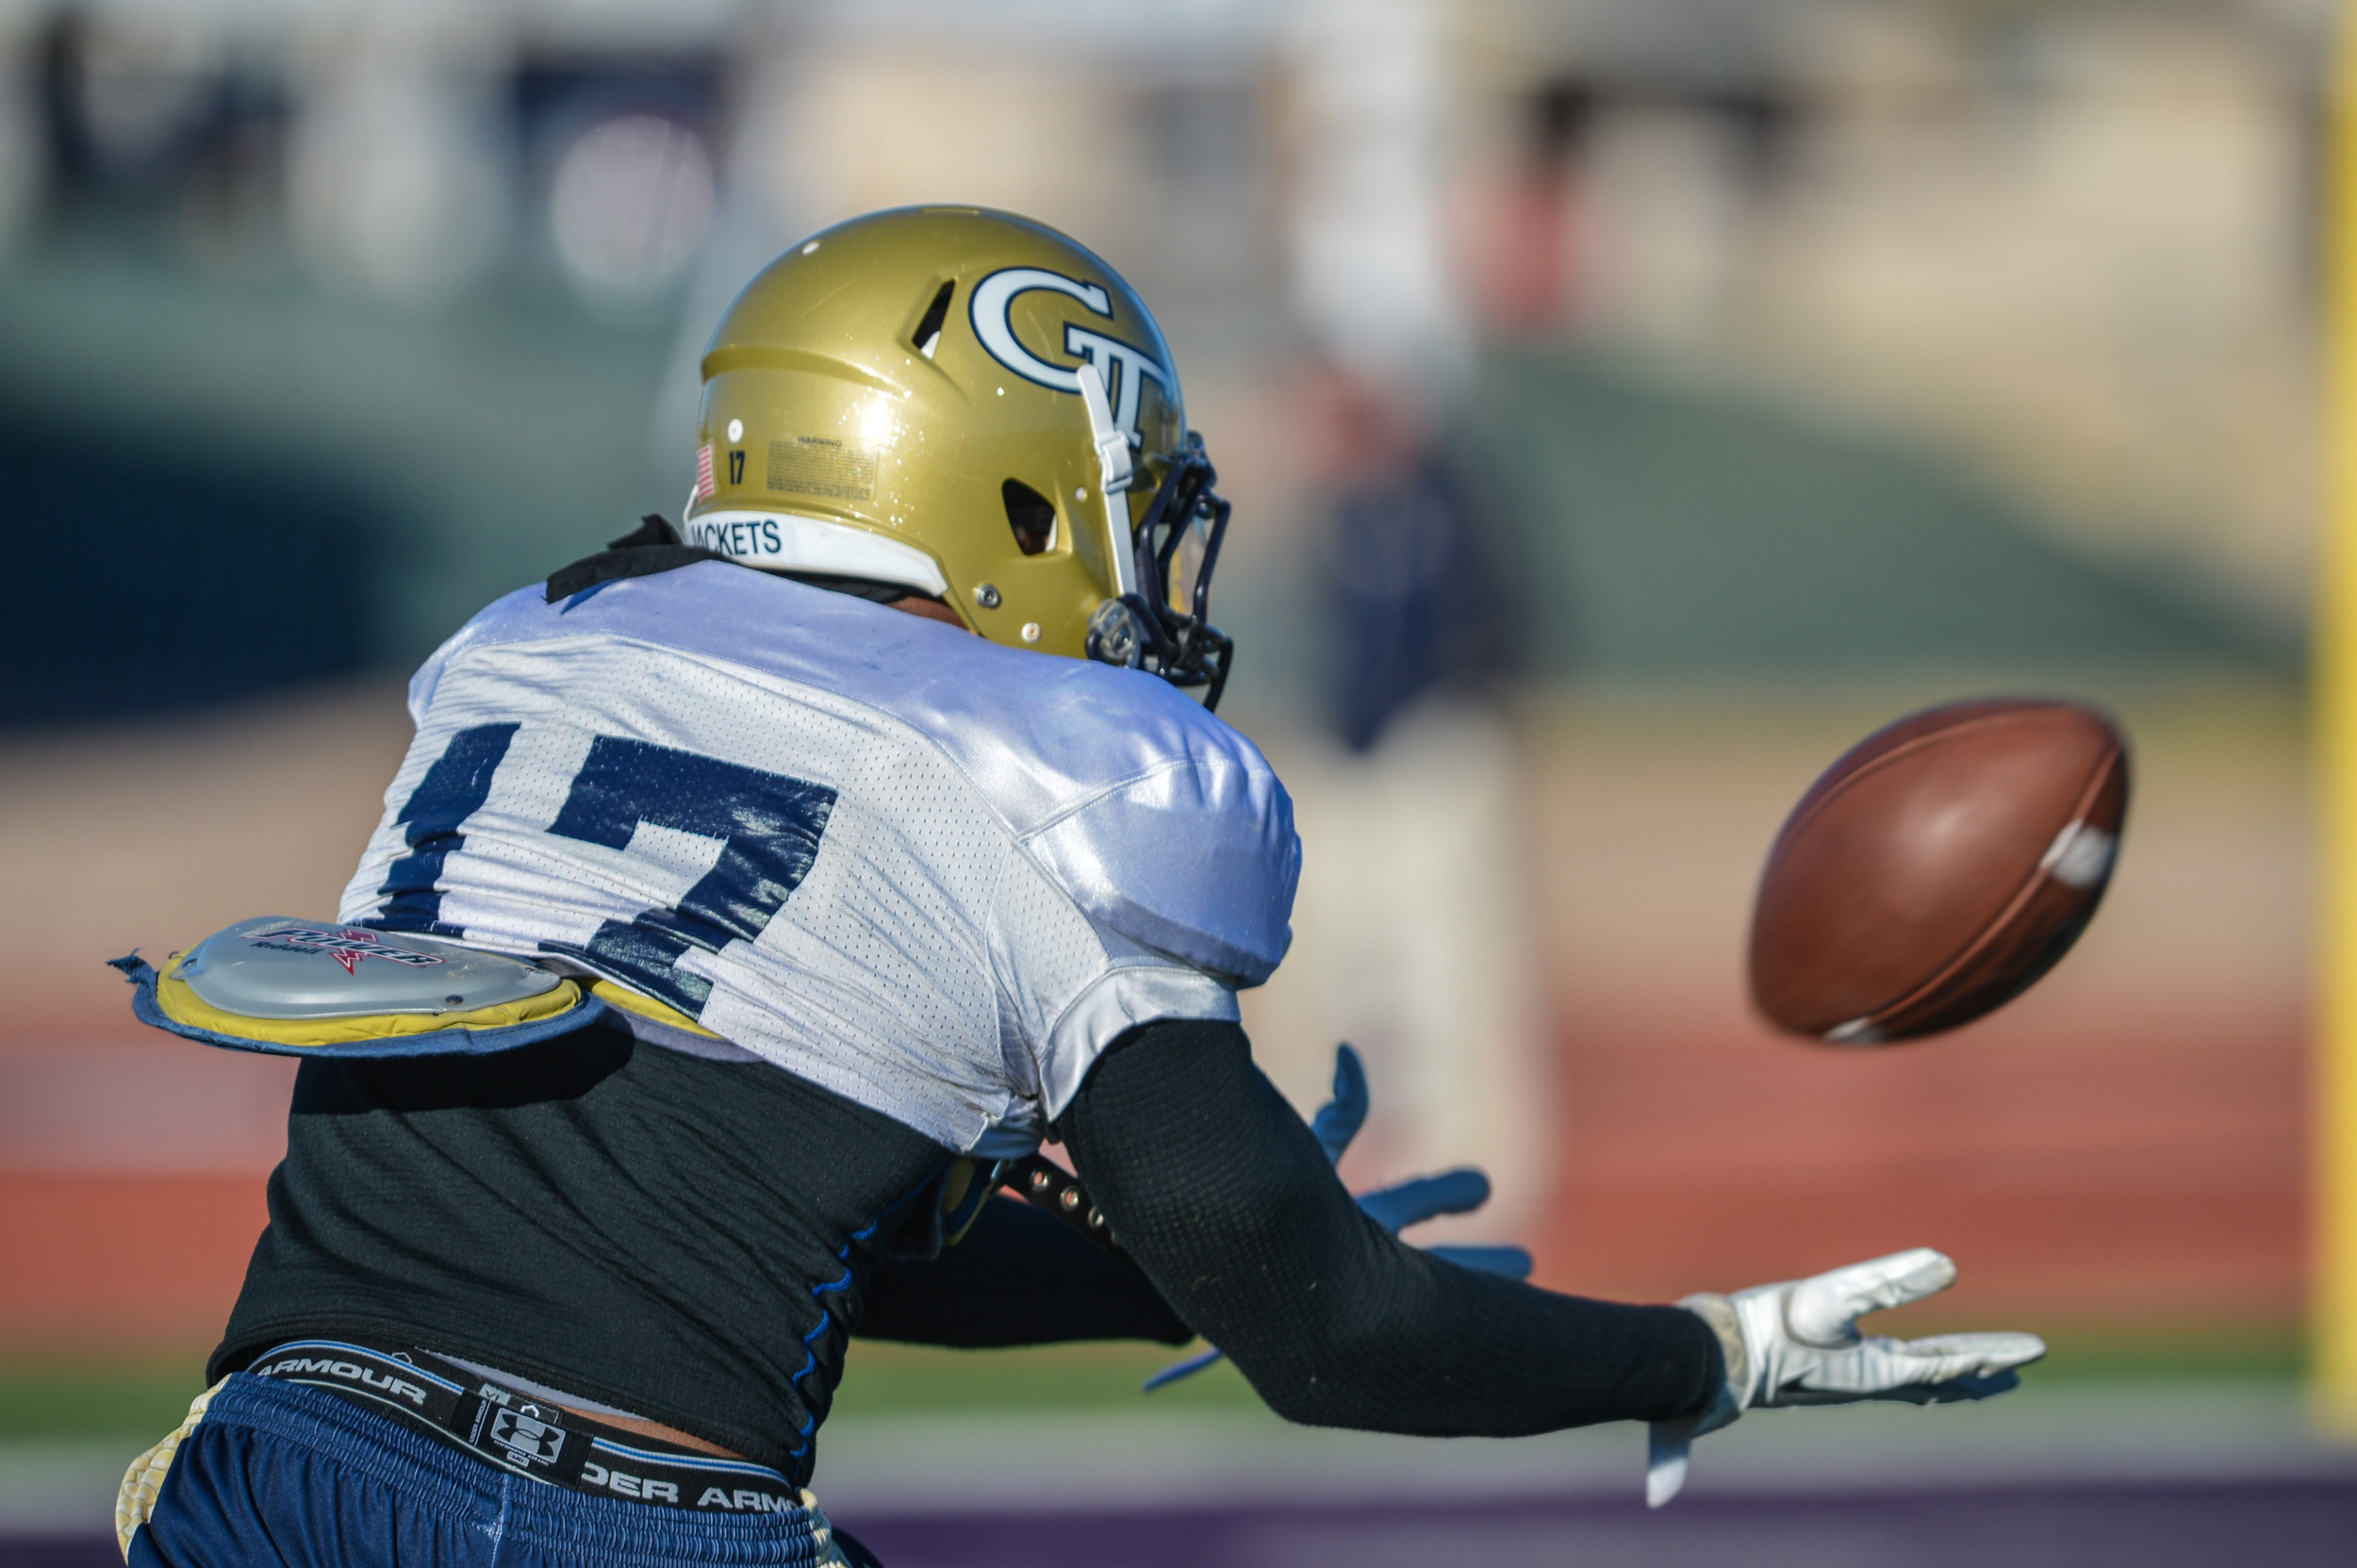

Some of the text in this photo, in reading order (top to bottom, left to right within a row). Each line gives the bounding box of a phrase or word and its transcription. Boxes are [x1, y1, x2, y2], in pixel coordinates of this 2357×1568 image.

[798, 436, 842, 447] WARNING
[729, 450, 745, 486] 17
[351, 721, 839, 1023] 17
[241, 927, 444, 966] POWER
[250, 941, 324, 954] Riddell
[257, 1359, 427, 1405] ARMOUR
